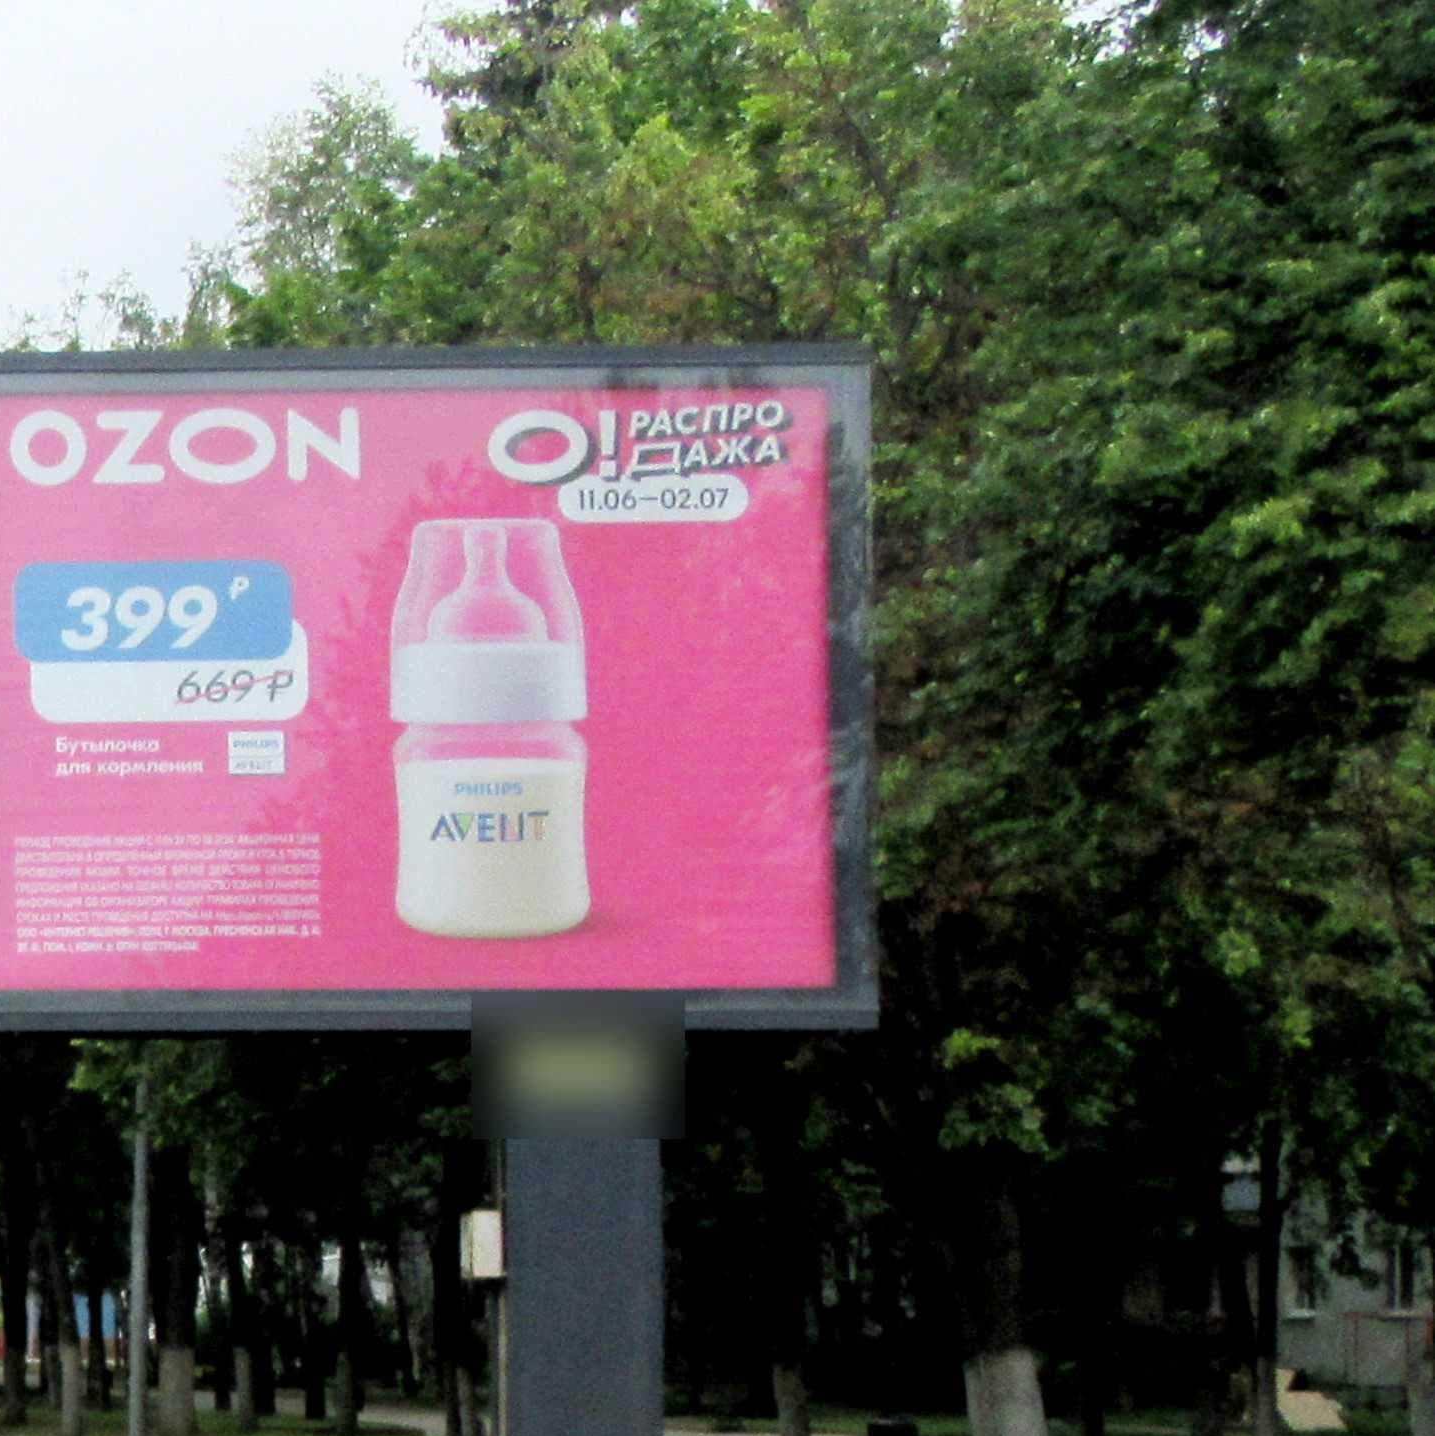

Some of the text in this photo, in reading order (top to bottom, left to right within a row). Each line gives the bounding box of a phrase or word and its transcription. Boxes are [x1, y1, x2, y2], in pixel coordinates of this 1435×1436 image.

[628, 400, 786, 438] РАСПРО
[9, 407, 361, 486] OZON
[61, 585, 218, 651] 399
[176, 670, 255, 704] 669
[55, 736, 161, 757] Бутылочка
[55, 761, 204, 777] для кормления
